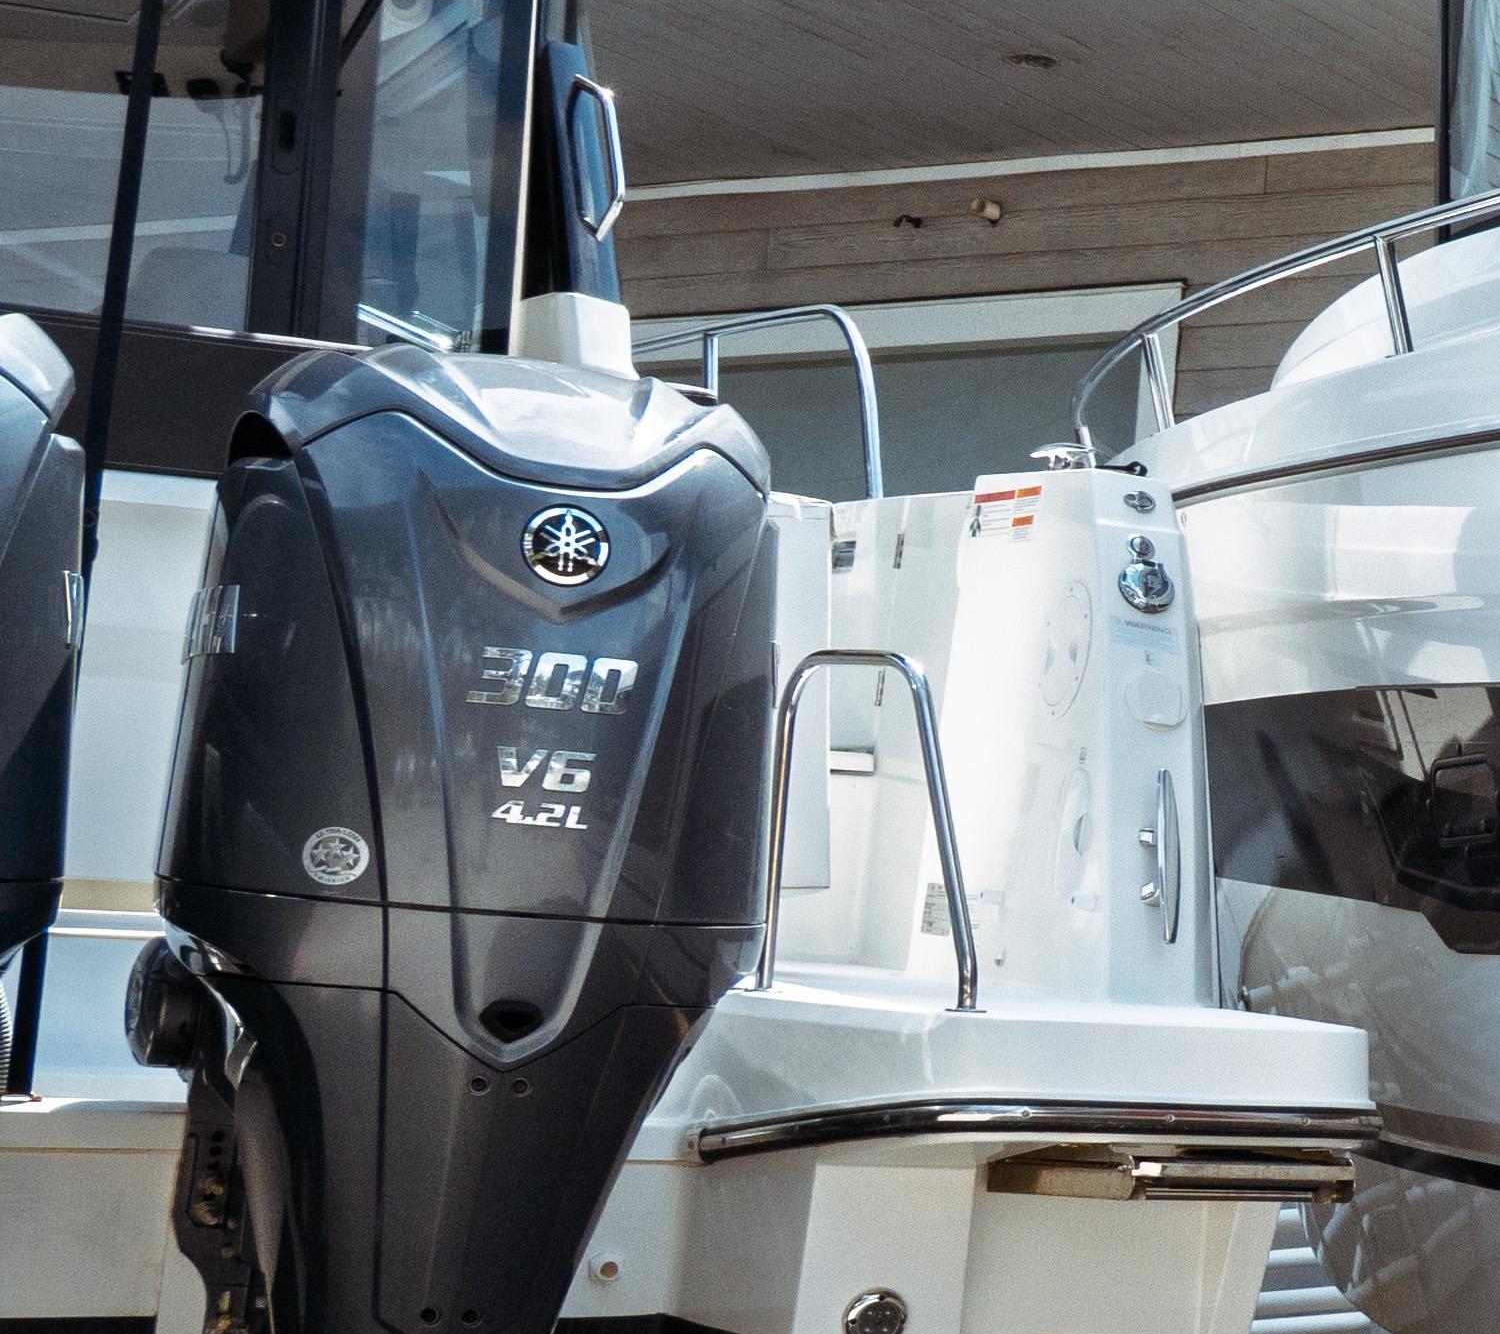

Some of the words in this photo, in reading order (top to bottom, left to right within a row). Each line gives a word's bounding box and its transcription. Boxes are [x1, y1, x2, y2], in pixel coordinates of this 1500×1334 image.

[465, 645, 639, 716] 300
[497, 745, 597, 793] V6
[490, 800, 588, 830] 4.2L
